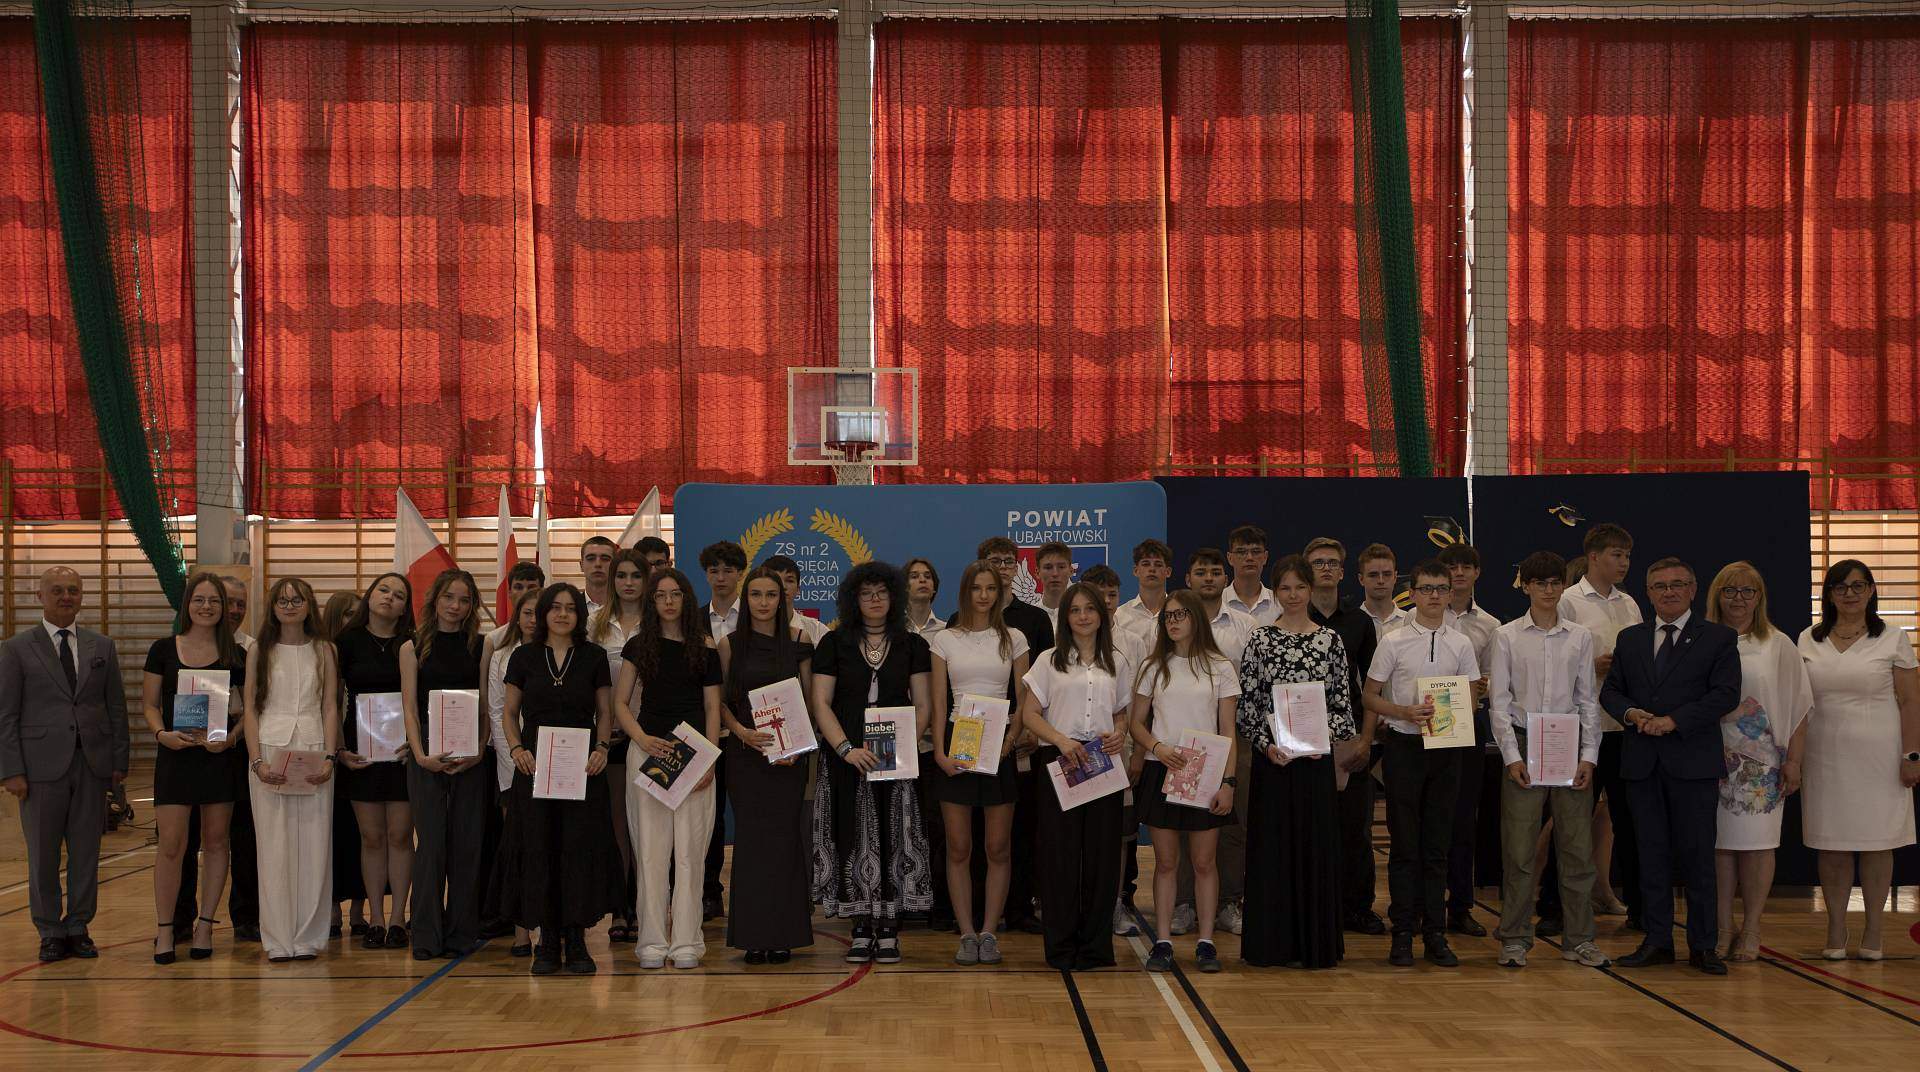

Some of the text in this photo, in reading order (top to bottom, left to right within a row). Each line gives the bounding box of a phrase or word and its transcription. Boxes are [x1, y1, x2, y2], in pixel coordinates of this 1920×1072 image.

[1007, 508, 1108, 527] POWIAT
[775, 542, 829, 556] ZS nr 2
[794, 560, 839, 574] SIĘCIA
[799, 575, 840, 586] KAROL
[1430, 681, 1458, 689] DYPLOM
[754, 706, 782, 720] Ahern
